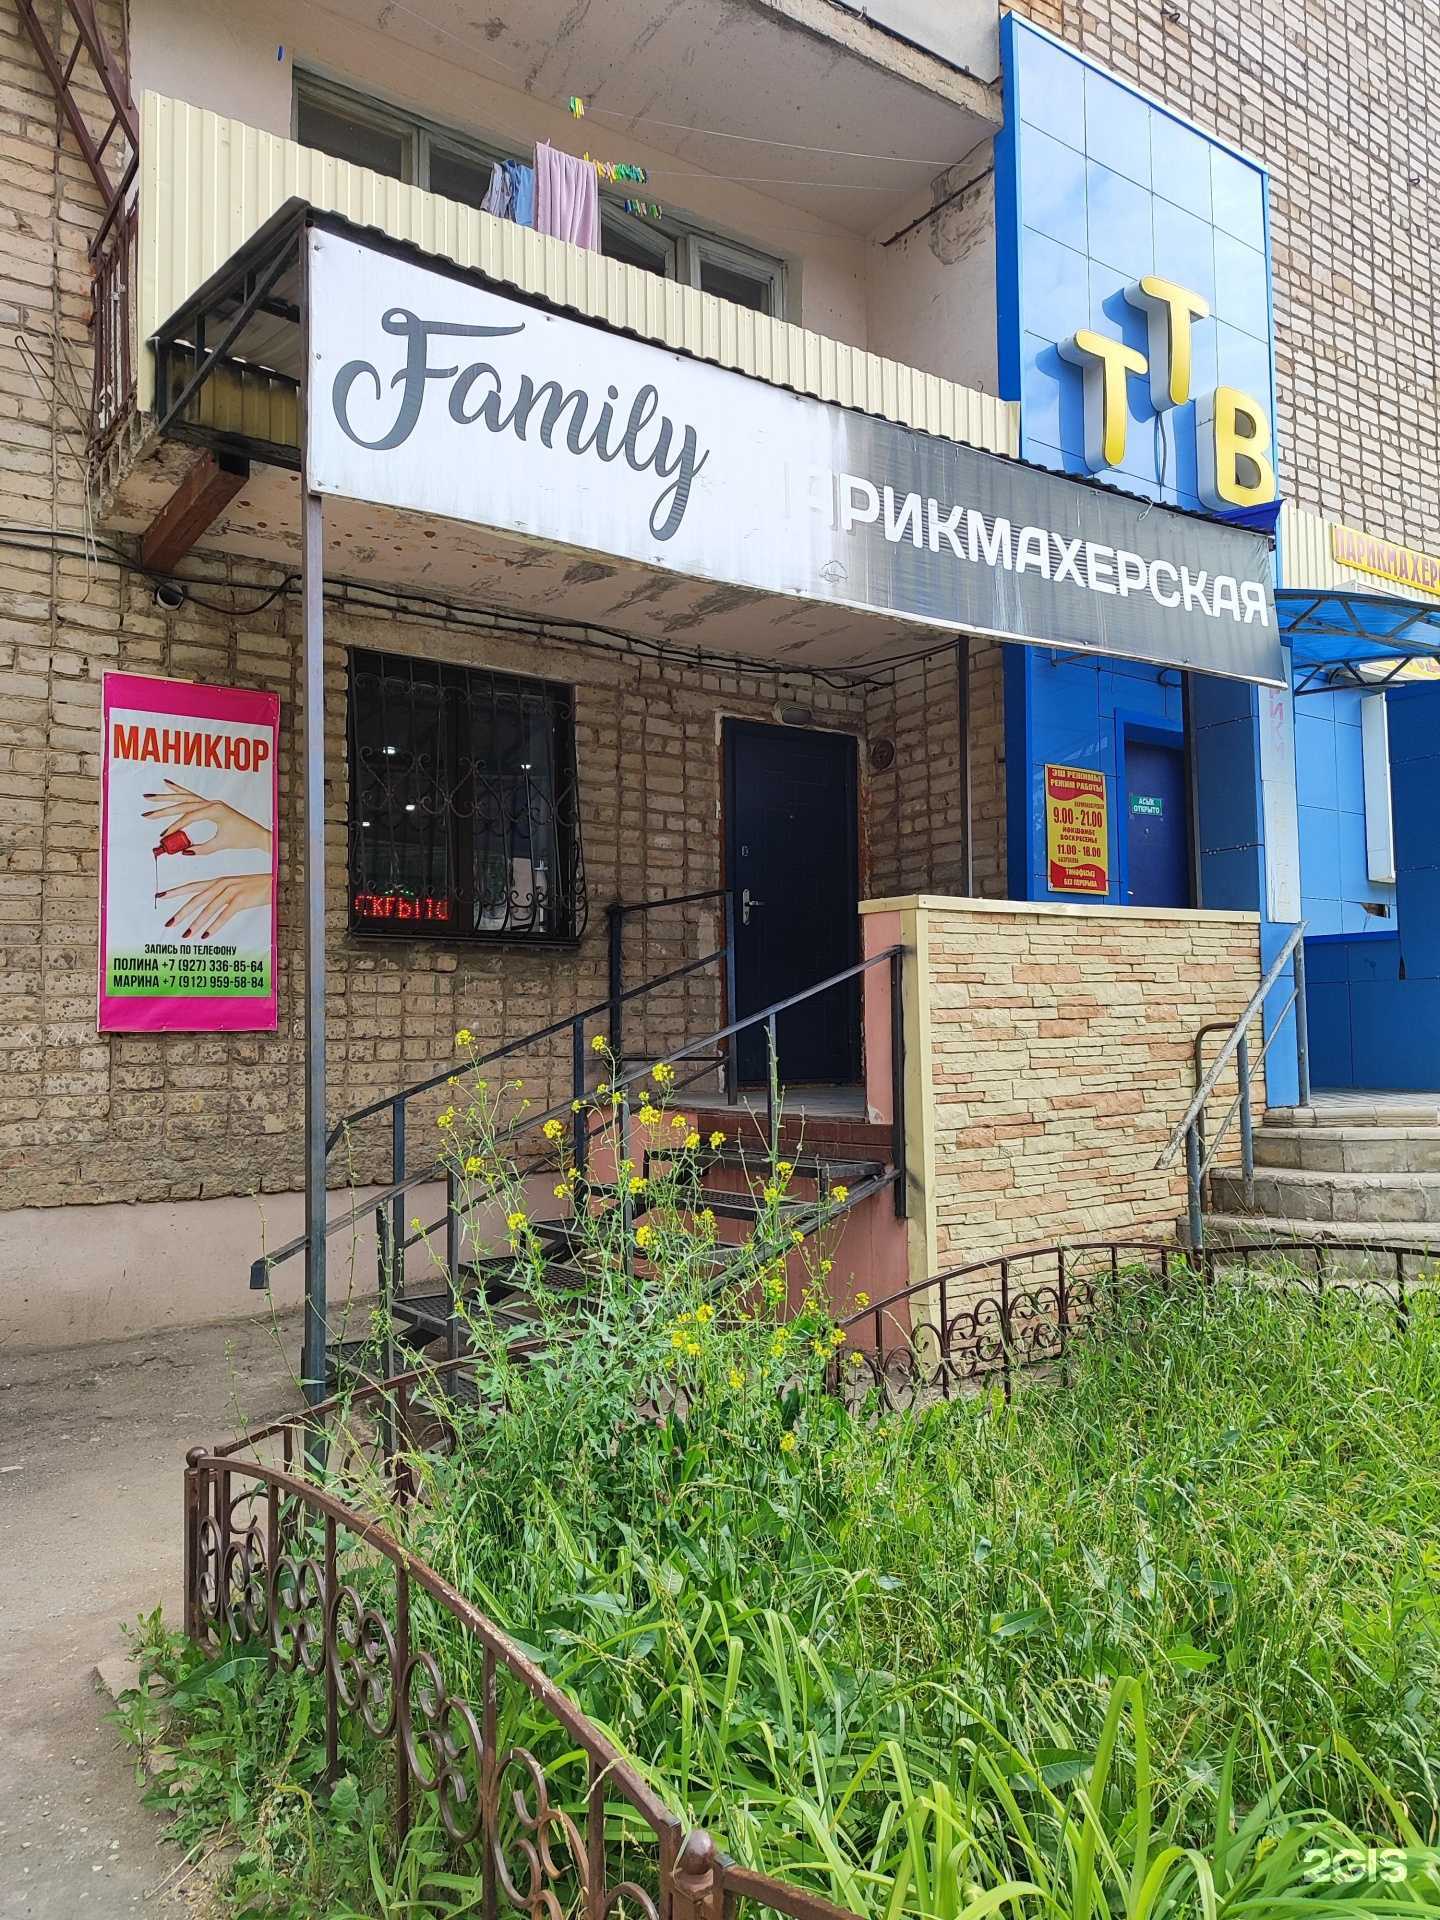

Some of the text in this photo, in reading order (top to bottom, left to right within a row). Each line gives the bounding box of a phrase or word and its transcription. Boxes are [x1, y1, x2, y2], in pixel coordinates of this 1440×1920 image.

[332, 308, 710, 541] Family
[786, 464, 1269, 627] РИКМАХЕРСКАЯ
[1335, 528, 1440, 589] ПАРИКМАХЕР
[113, 724, 269, 772] МАНИКЮР
[1076, 782, 1103, 793] РАБОТЫ
[1053, 806, 1073, 824] 9.00
[1080, 809, 1103, 828] 21.00
[1057, 844, 1077, 855] 11.00
[144, 943, 237, 956] ЗАПИСЬ ПО ТЕЛЕФОНУ
[113, 958, 263, 972] ПОЛИНА +7 (927) 336-85-64
[113, 975, 264, 988] МАРИНА +7 (912) 959-58-84
